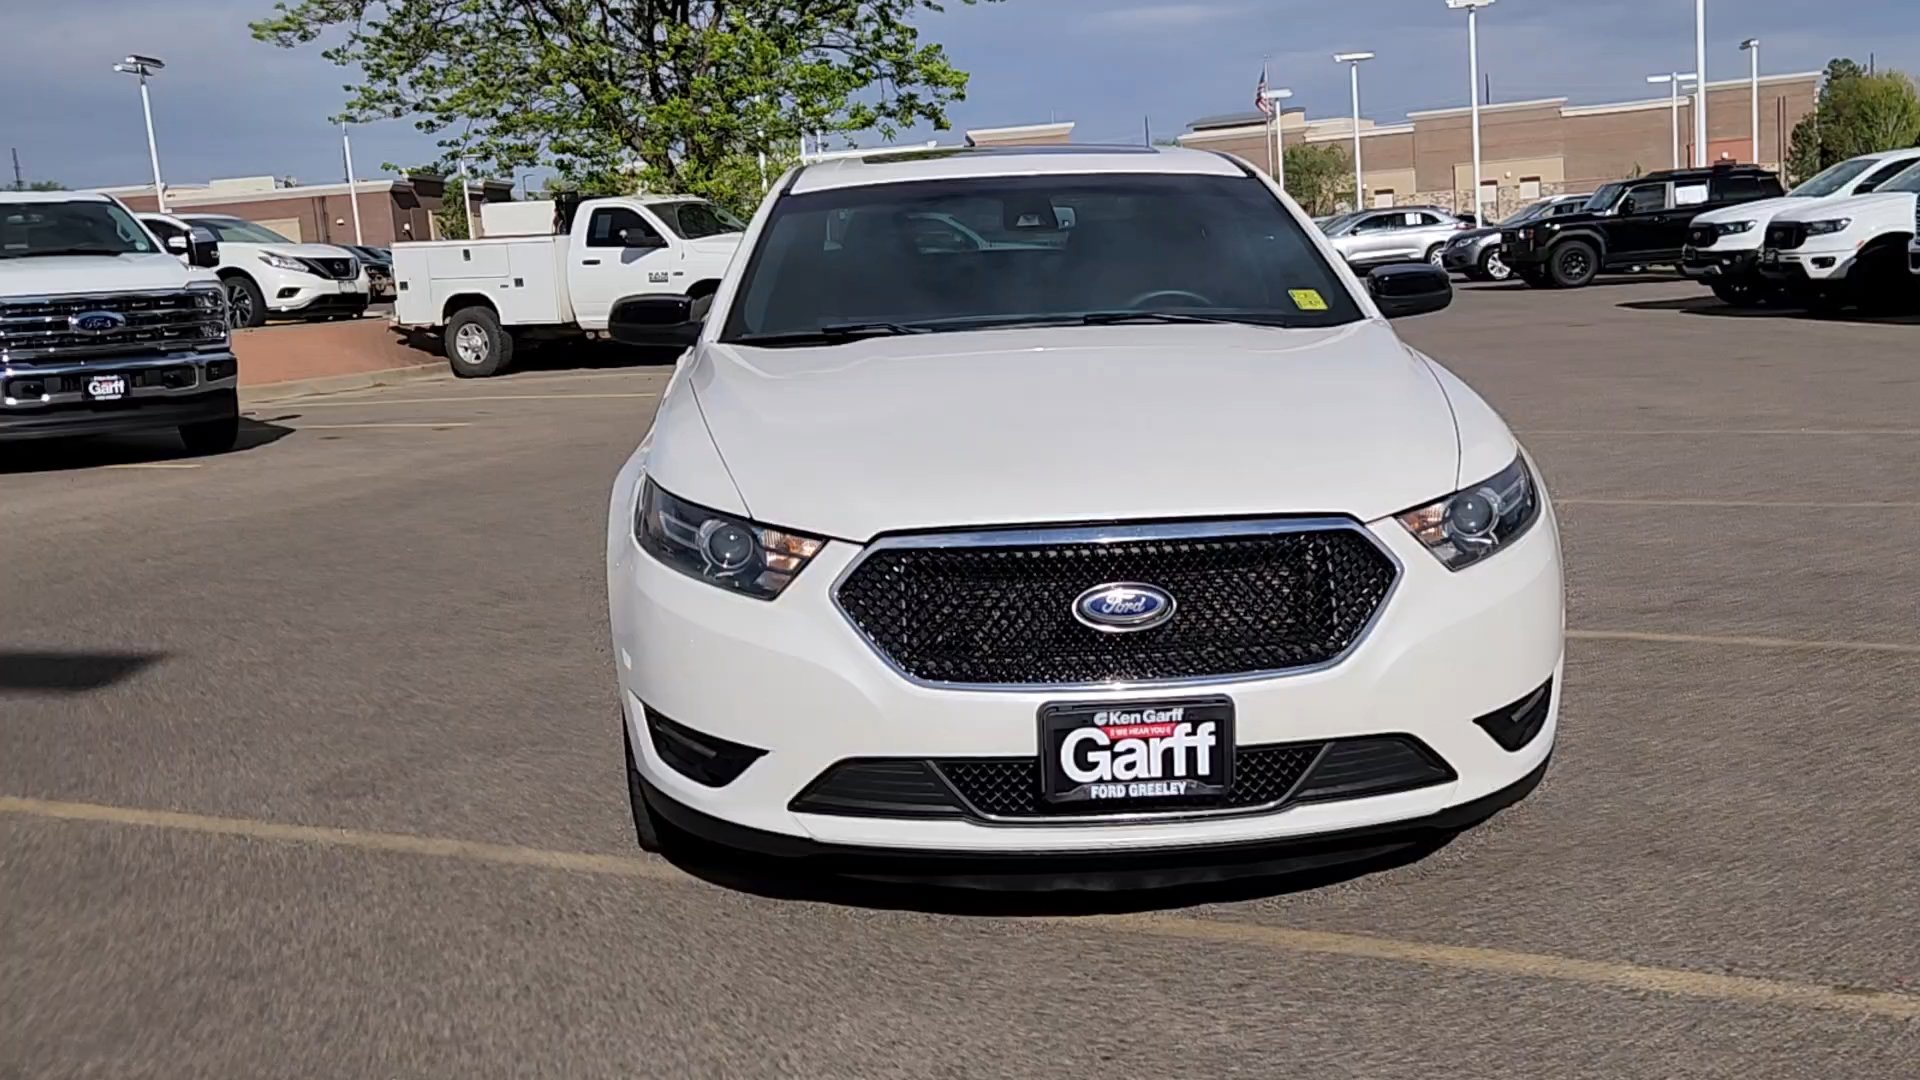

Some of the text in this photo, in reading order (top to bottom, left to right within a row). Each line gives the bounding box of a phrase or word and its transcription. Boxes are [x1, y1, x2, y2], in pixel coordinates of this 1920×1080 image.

[1101, 594, 1147, 614] Ford
[1109, 708, 1184, 725] Ken Garff
[1060, 721, 1216, 783] Garff
[1091, 780, 1186, 799] FORD GREELEY
